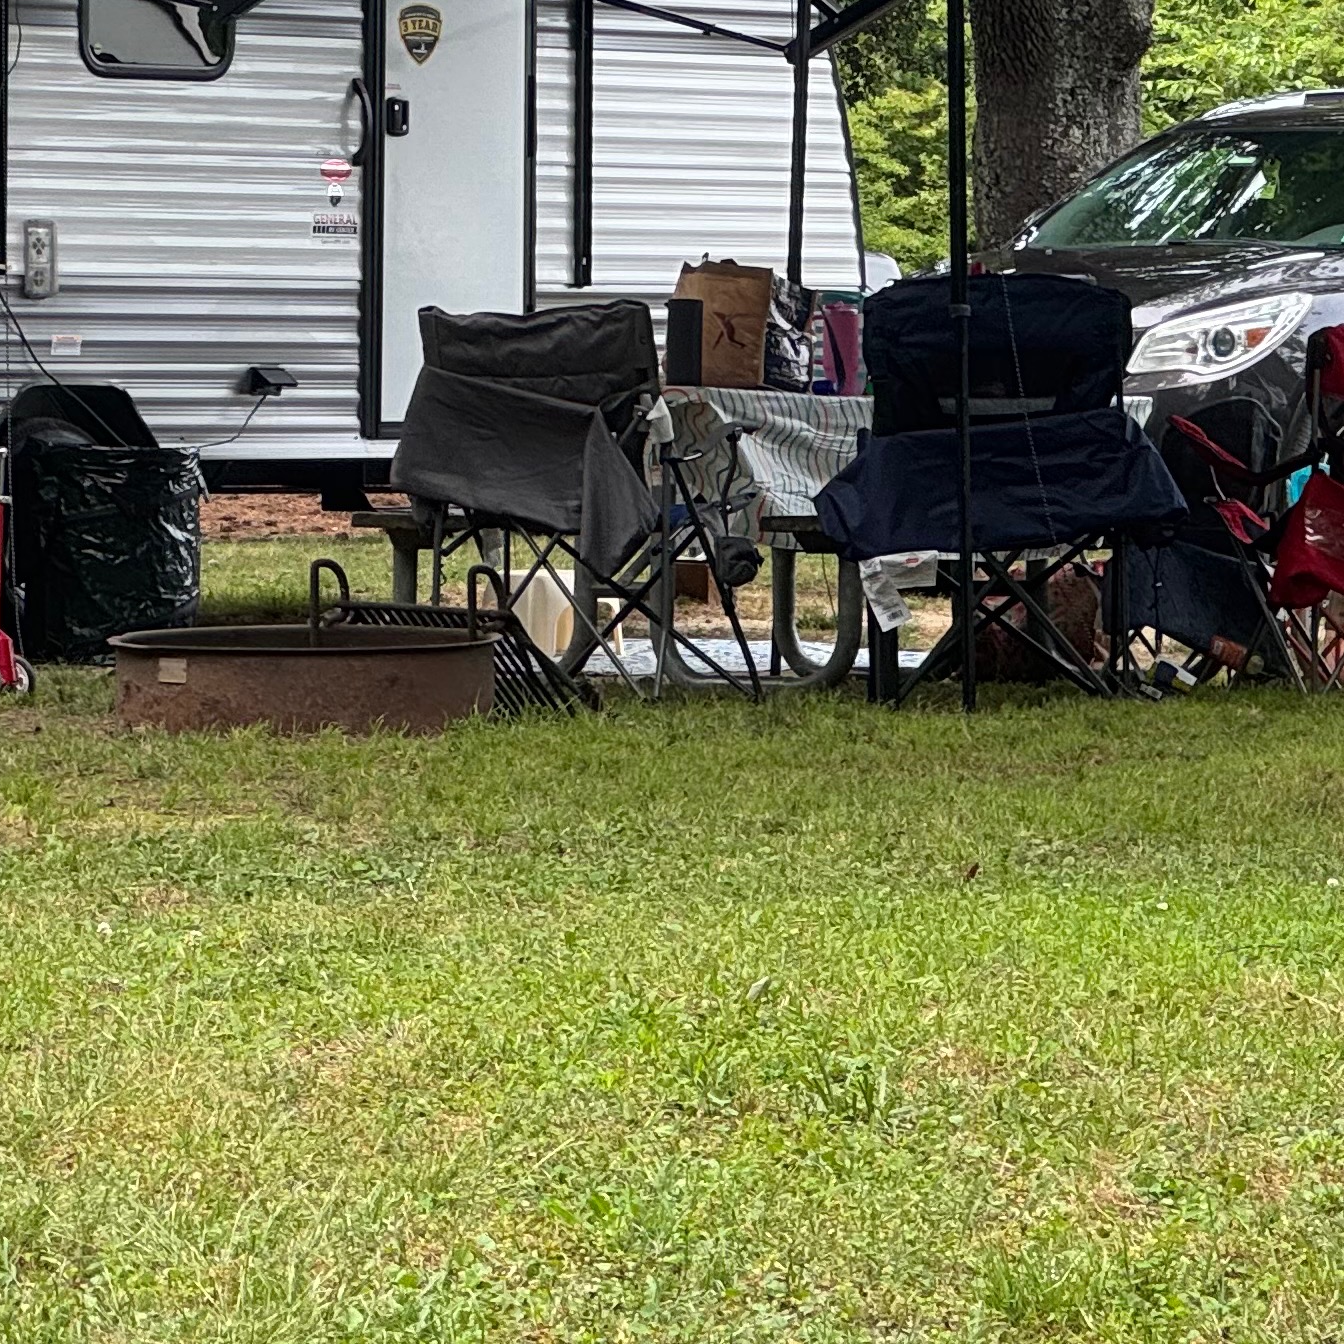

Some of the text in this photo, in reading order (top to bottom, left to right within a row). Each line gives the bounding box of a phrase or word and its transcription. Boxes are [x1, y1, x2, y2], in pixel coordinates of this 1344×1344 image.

[402, 19, 438, 34] 3 YEAR
[313, 213, 358, 226] GENERAL
